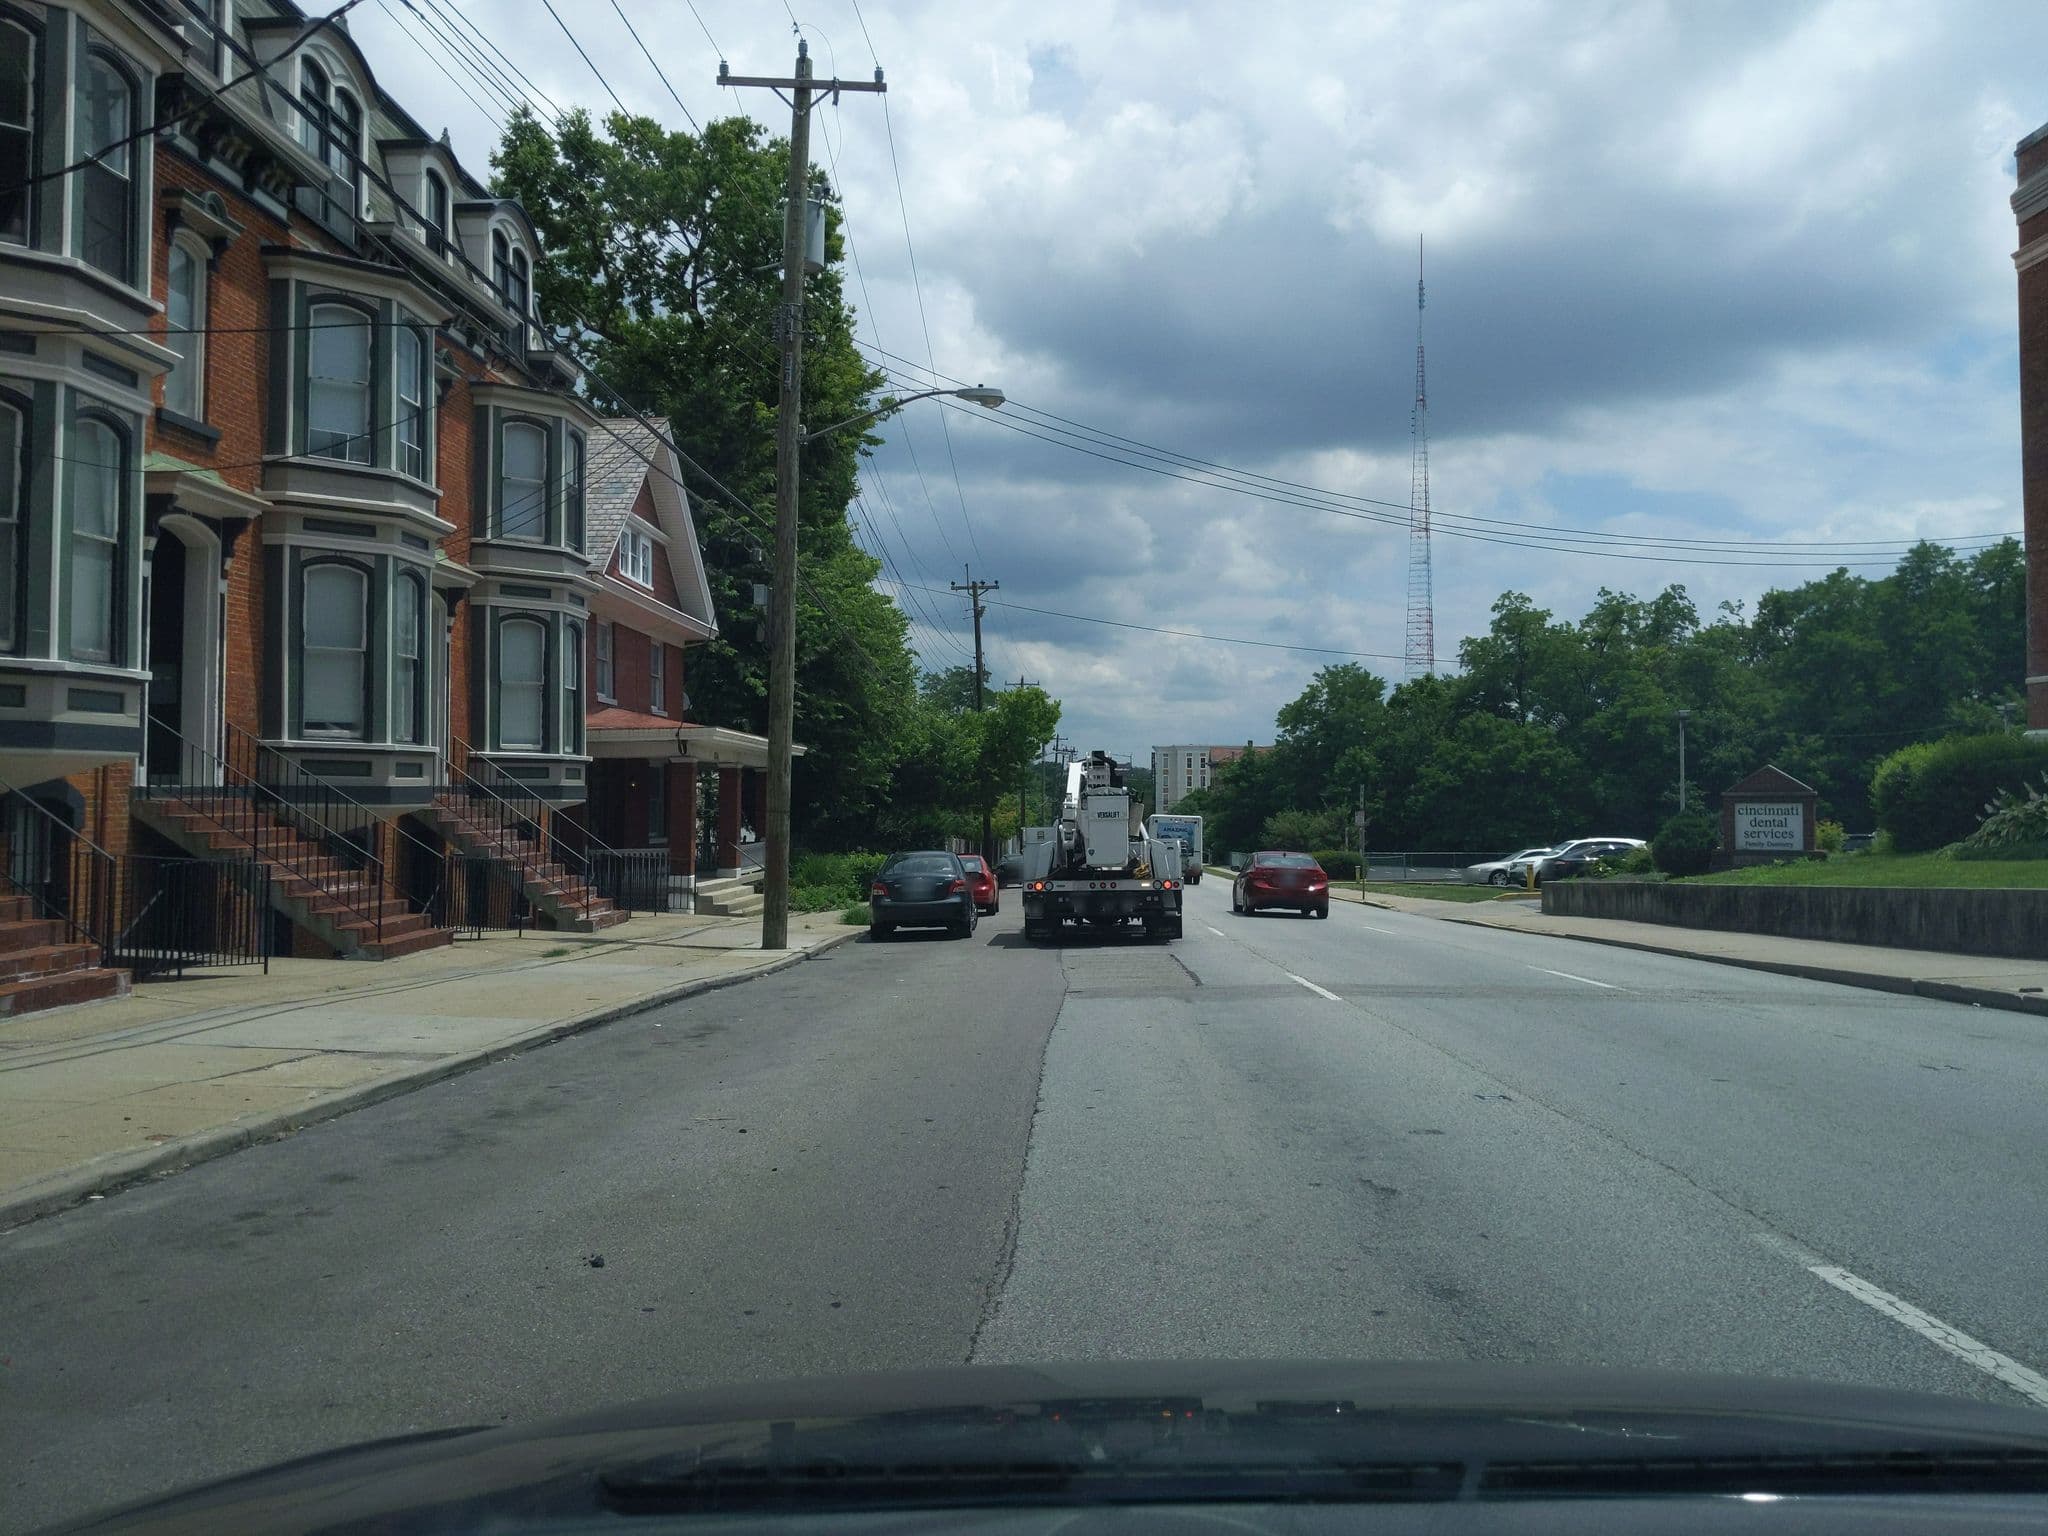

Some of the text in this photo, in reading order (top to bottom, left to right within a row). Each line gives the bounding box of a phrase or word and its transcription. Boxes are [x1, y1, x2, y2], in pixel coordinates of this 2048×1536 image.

[1737, 804, 1799, 816] cincinnati
[1749, 816, 1787, 827] dental
[1743, 828, 1794, 839] services
